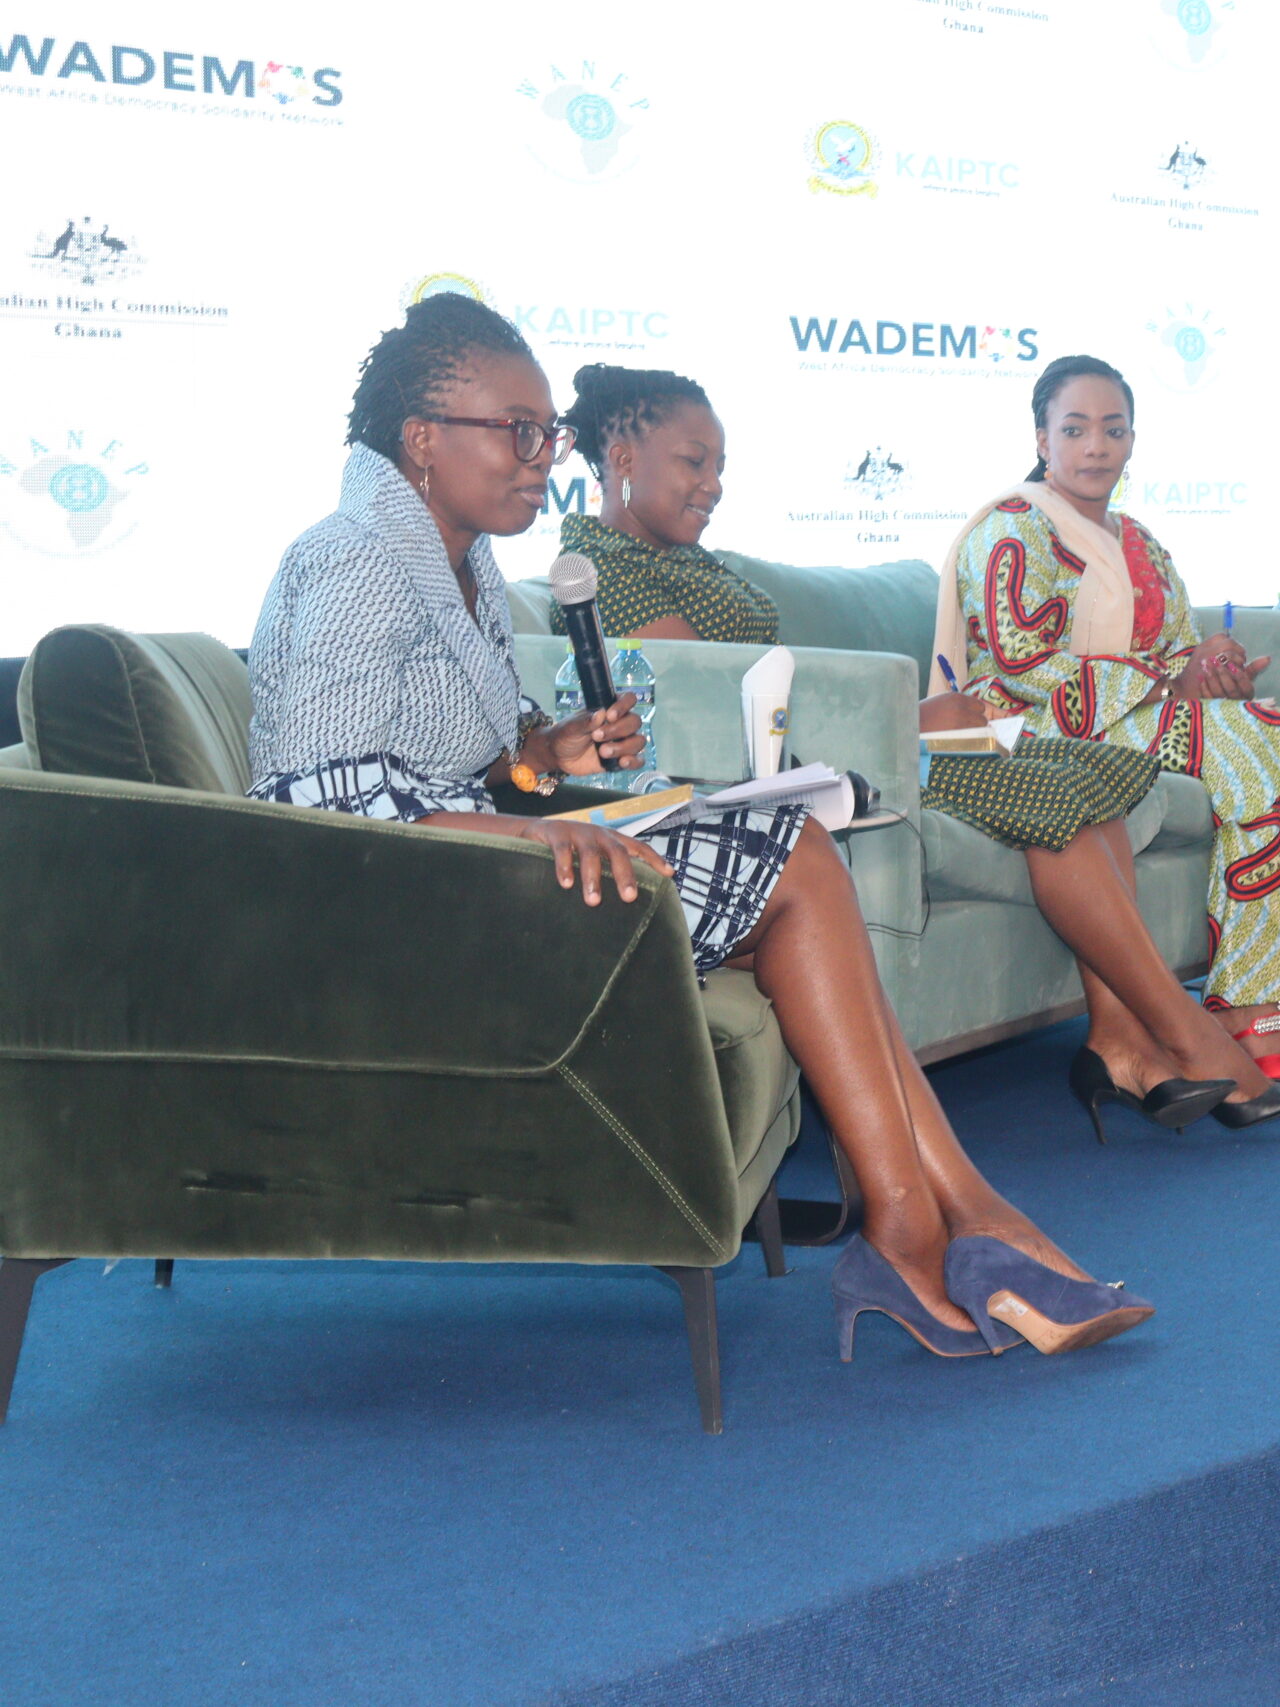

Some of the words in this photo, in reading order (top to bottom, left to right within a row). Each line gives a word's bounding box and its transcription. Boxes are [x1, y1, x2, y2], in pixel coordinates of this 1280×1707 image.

[896, 151, 1020, 188] KAIPTC
[515, 304, 670, 338] KAIPTC
[1143, 481, 1248, 504] KAIPTC
[857, 532, 900, 543] Ghana
